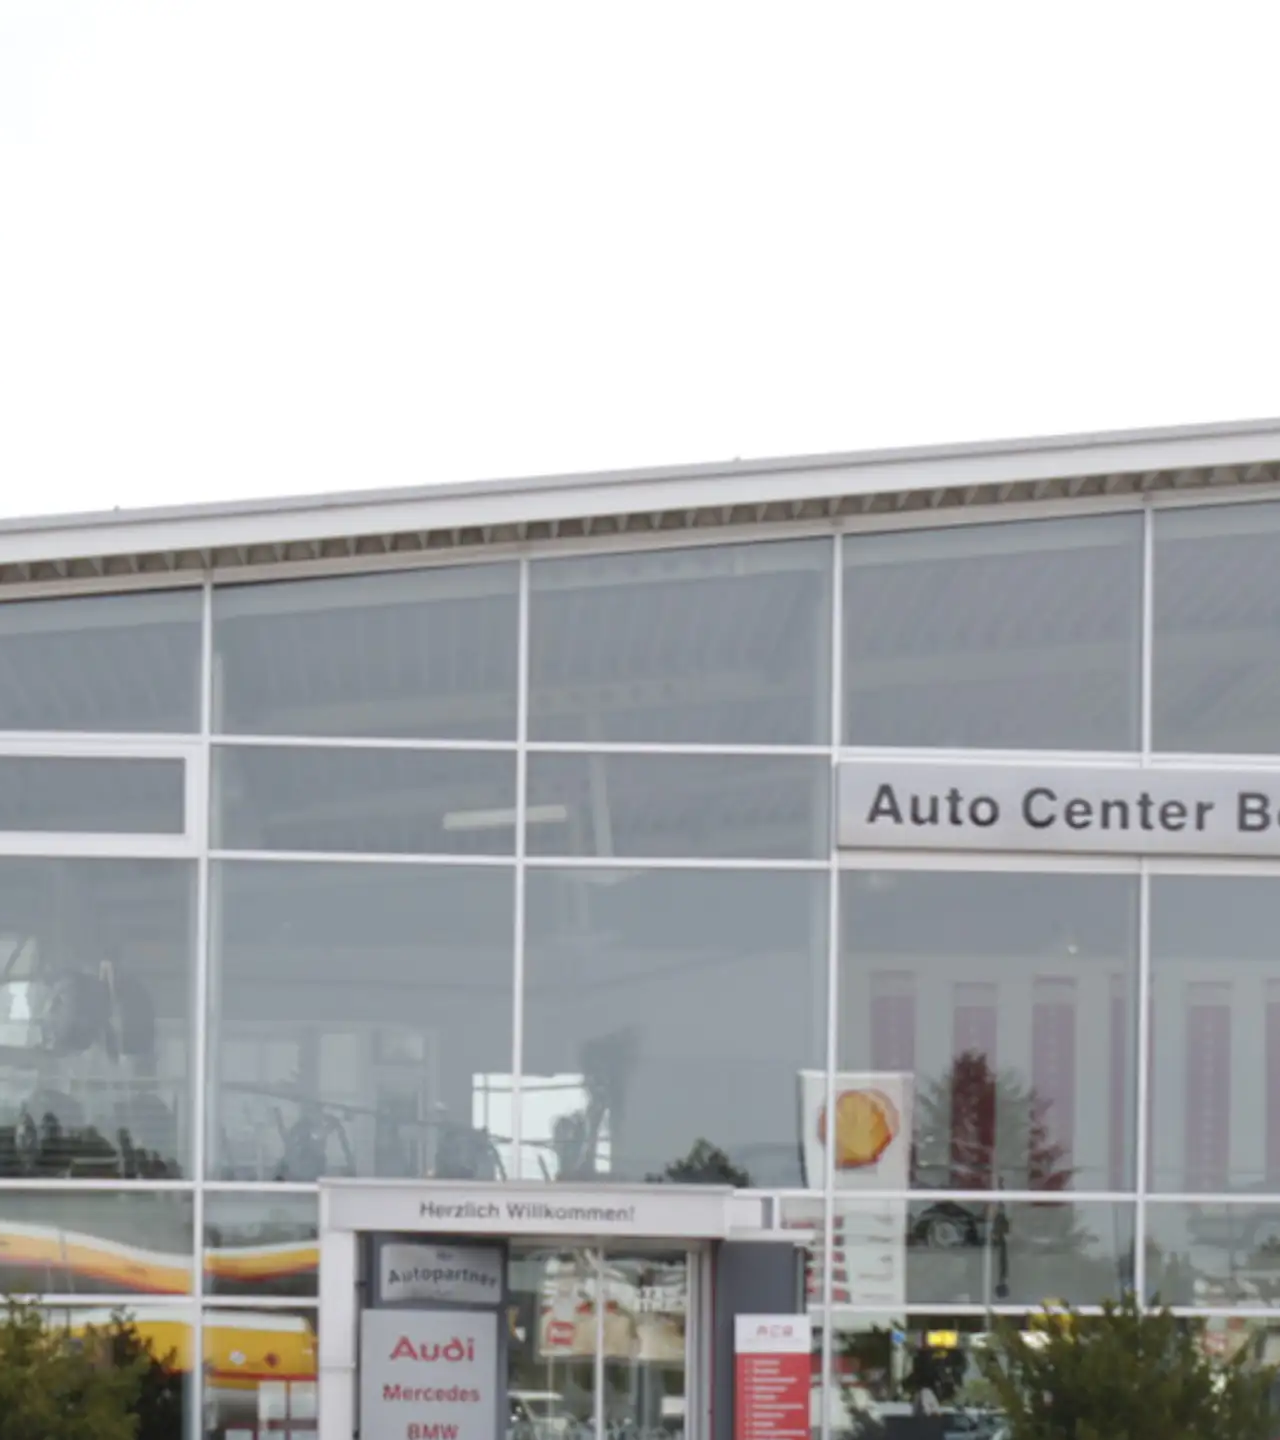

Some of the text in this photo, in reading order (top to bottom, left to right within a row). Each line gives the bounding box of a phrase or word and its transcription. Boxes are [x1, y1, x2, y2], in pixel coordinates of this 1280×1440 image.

[866, 784, 1000, 827] Auto
[1022, 787, 1214, 832] Center
[420, 1201, 636, 1222] Herzlich Willkommen!
[388, 1263, 497, 1287] Autopartner
[389, 1336, 475, 1362] Audi
[382, 1384, 481, 1402] Mercedes
[406, 1423, 459, 1440] BMW
